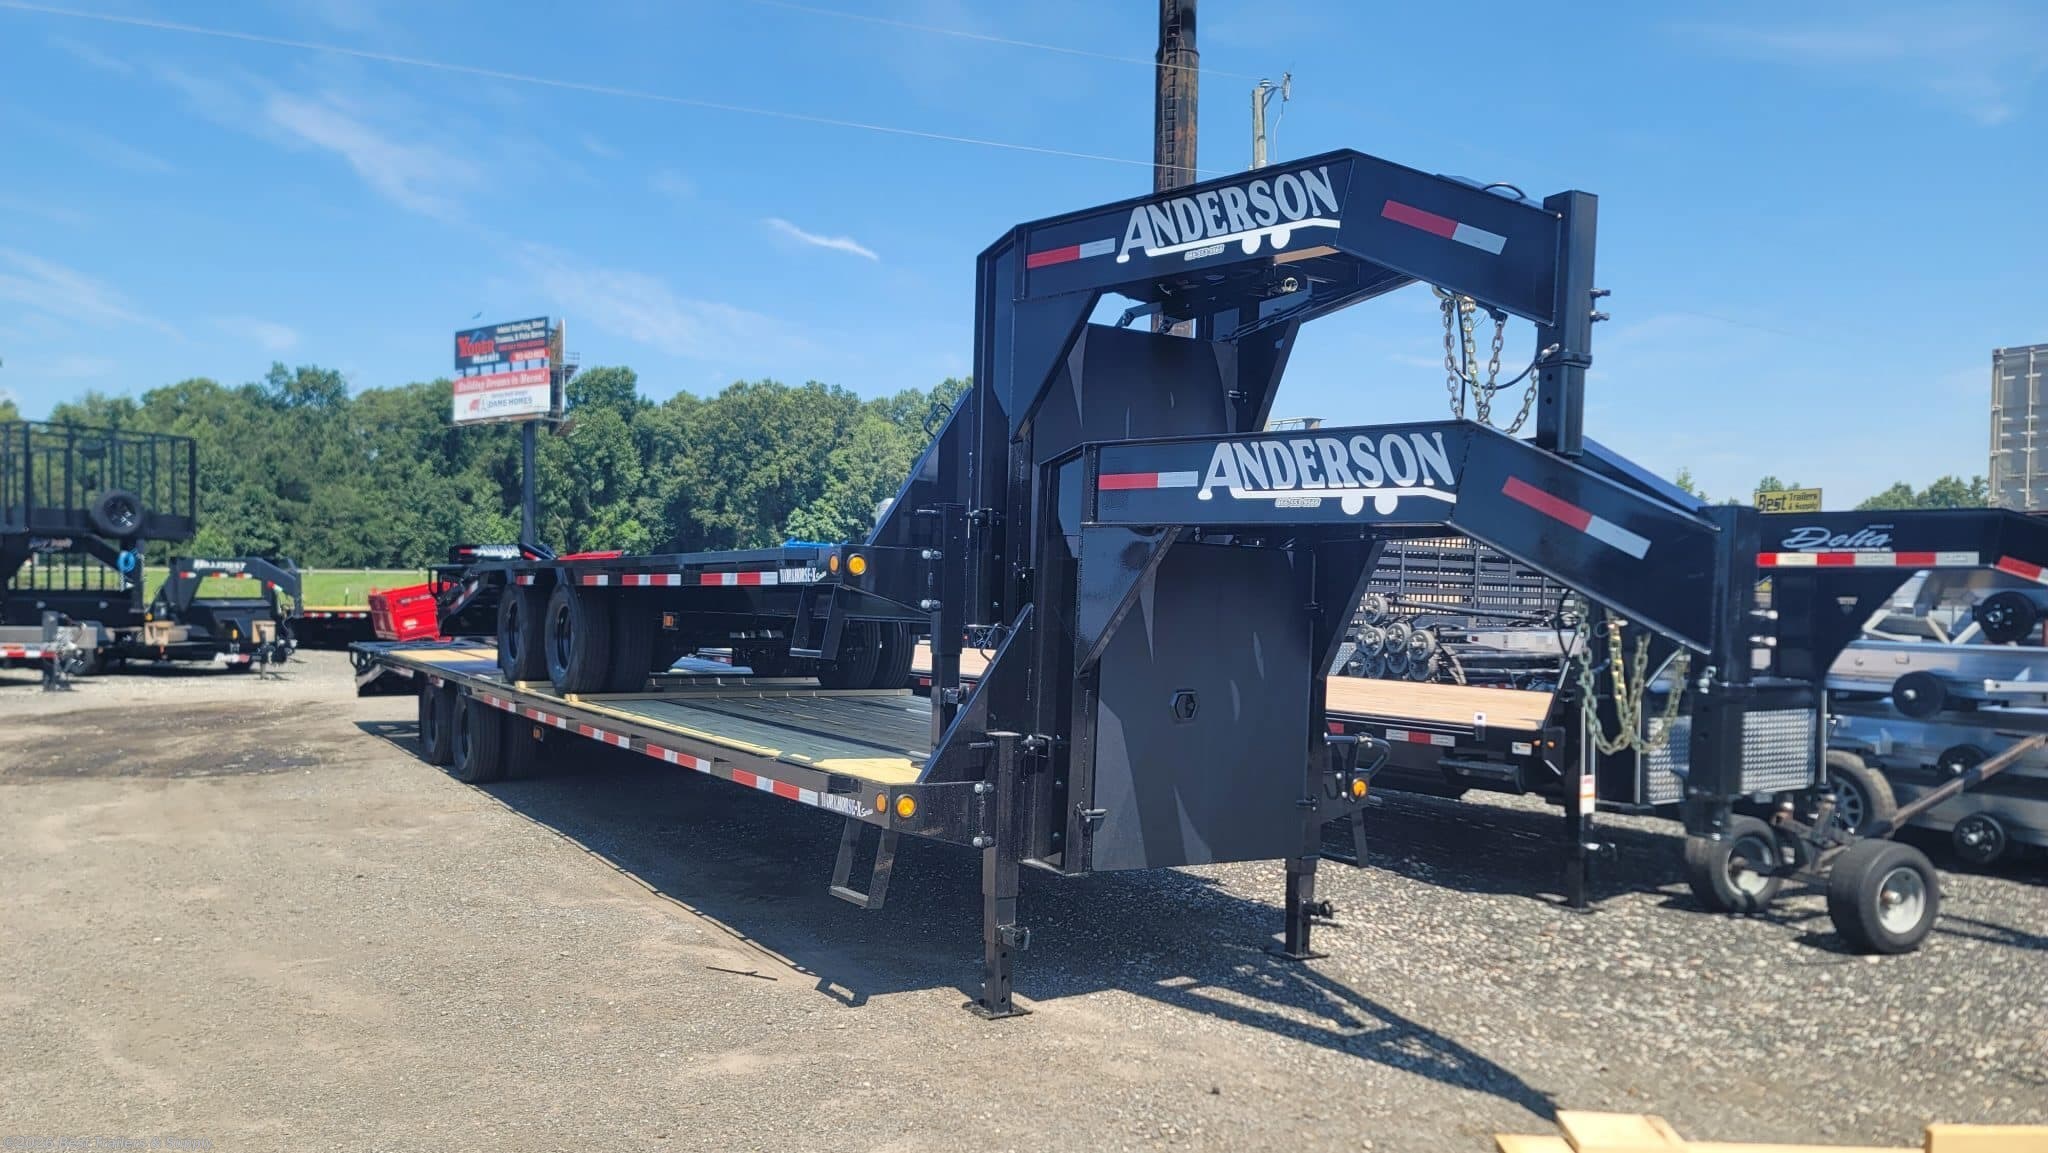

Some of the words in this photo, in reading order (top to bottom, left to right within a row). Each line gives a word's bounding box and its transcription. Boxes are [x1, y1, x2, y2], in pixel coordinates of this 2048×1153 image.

[1116, 167, 1339, 262] ANDERSON
[1198, 432, 1455, 499] ANDERSON
[1759, 494, 1786, 512] Best
[1781, 526, 1893, 549] Delta
